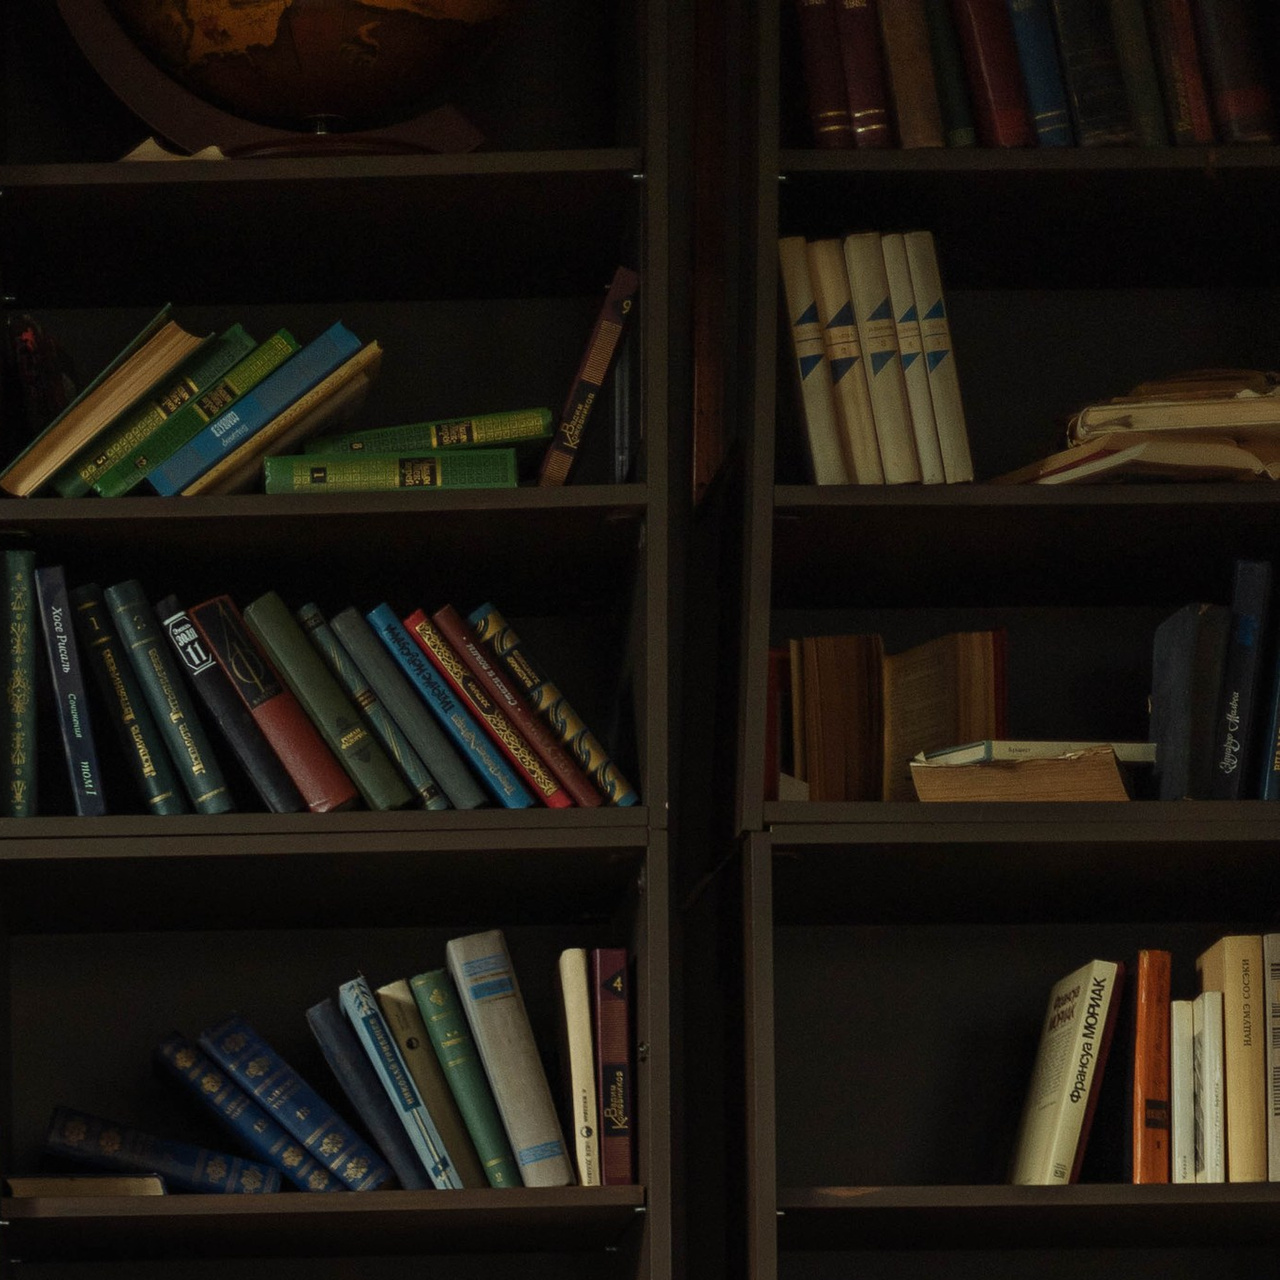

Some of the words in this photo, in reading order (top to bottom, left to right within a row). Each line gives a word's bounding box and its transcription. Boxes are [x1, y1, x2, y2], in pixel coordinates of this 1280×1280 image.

[51, 606, 65, 634] Хосе
[57, 634, 71, 674] Рисаль
[186, 643, 208, 667] 11
[467, 643, 493, 673] поэмы
[102, 648, 136, 723] Татьяничева
[148, 647, 184, 723] Татьяничева
[492, 675, 518, 706] Стихи
[69, 693, 83, 738] Сочинения
[129, 724, 156, 779] Людмила
[178, 723, 206, 776] Людмила
[1219, 730, 1241, 775] Эдуардо
[81, 761, 96, 784] том
[612, 976, 623, 992] 4
[1243, 959, 1251, 1000] СОСЭКИ
[1070, 1043, 1094, 1104] Франсуа
[1082, 977, 1107, 1040] МОРИАК
[1243, 1003, 1252, 1047] НАЦУМЭ
[392, 1064, 415, 1105] НИКОЛАЙ
